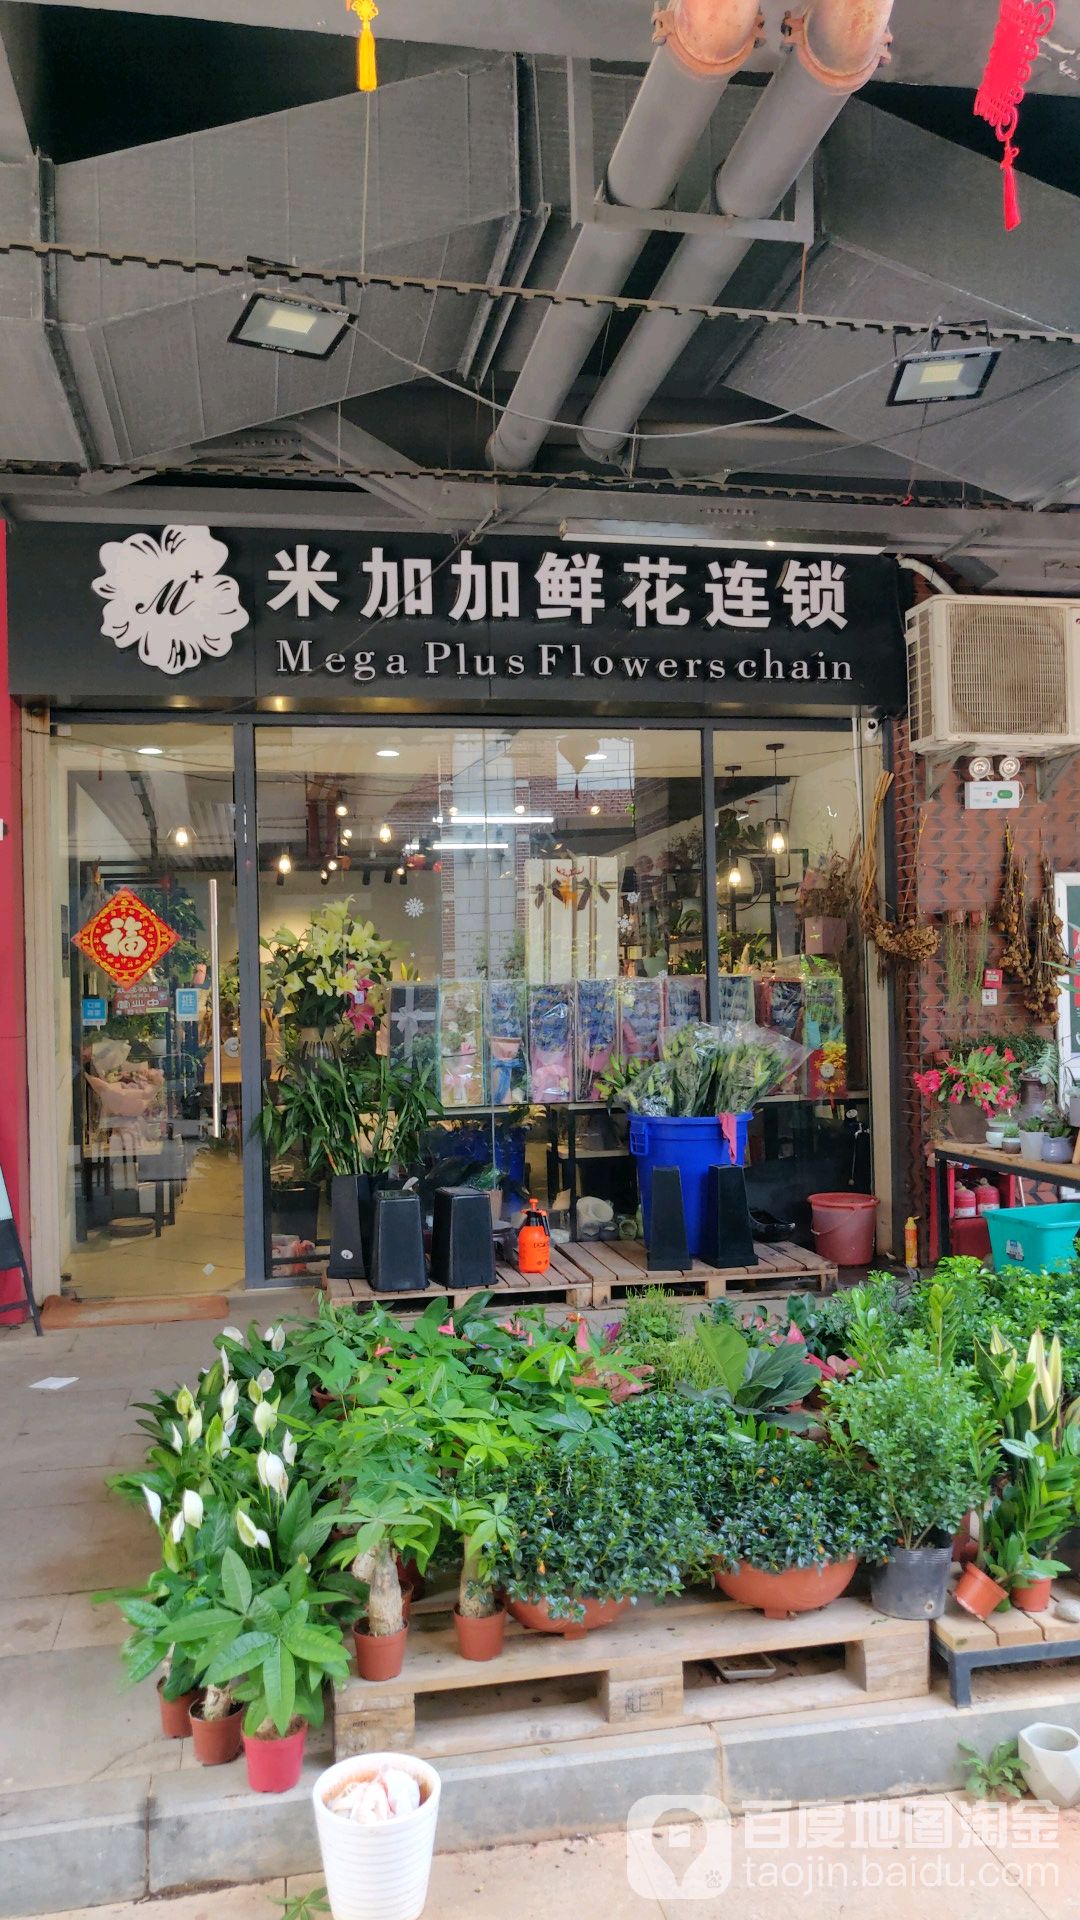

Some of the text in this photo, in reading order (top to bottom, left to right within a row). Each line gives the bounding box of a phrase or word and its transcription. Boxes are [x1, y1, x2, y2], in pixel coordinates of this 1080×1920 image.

[266, 545, 848, 630] 米加加鲜花连锁
[275, 640, 853, 681] Mega Plus Flowers chain
[101, 916, 147, 958] 福
